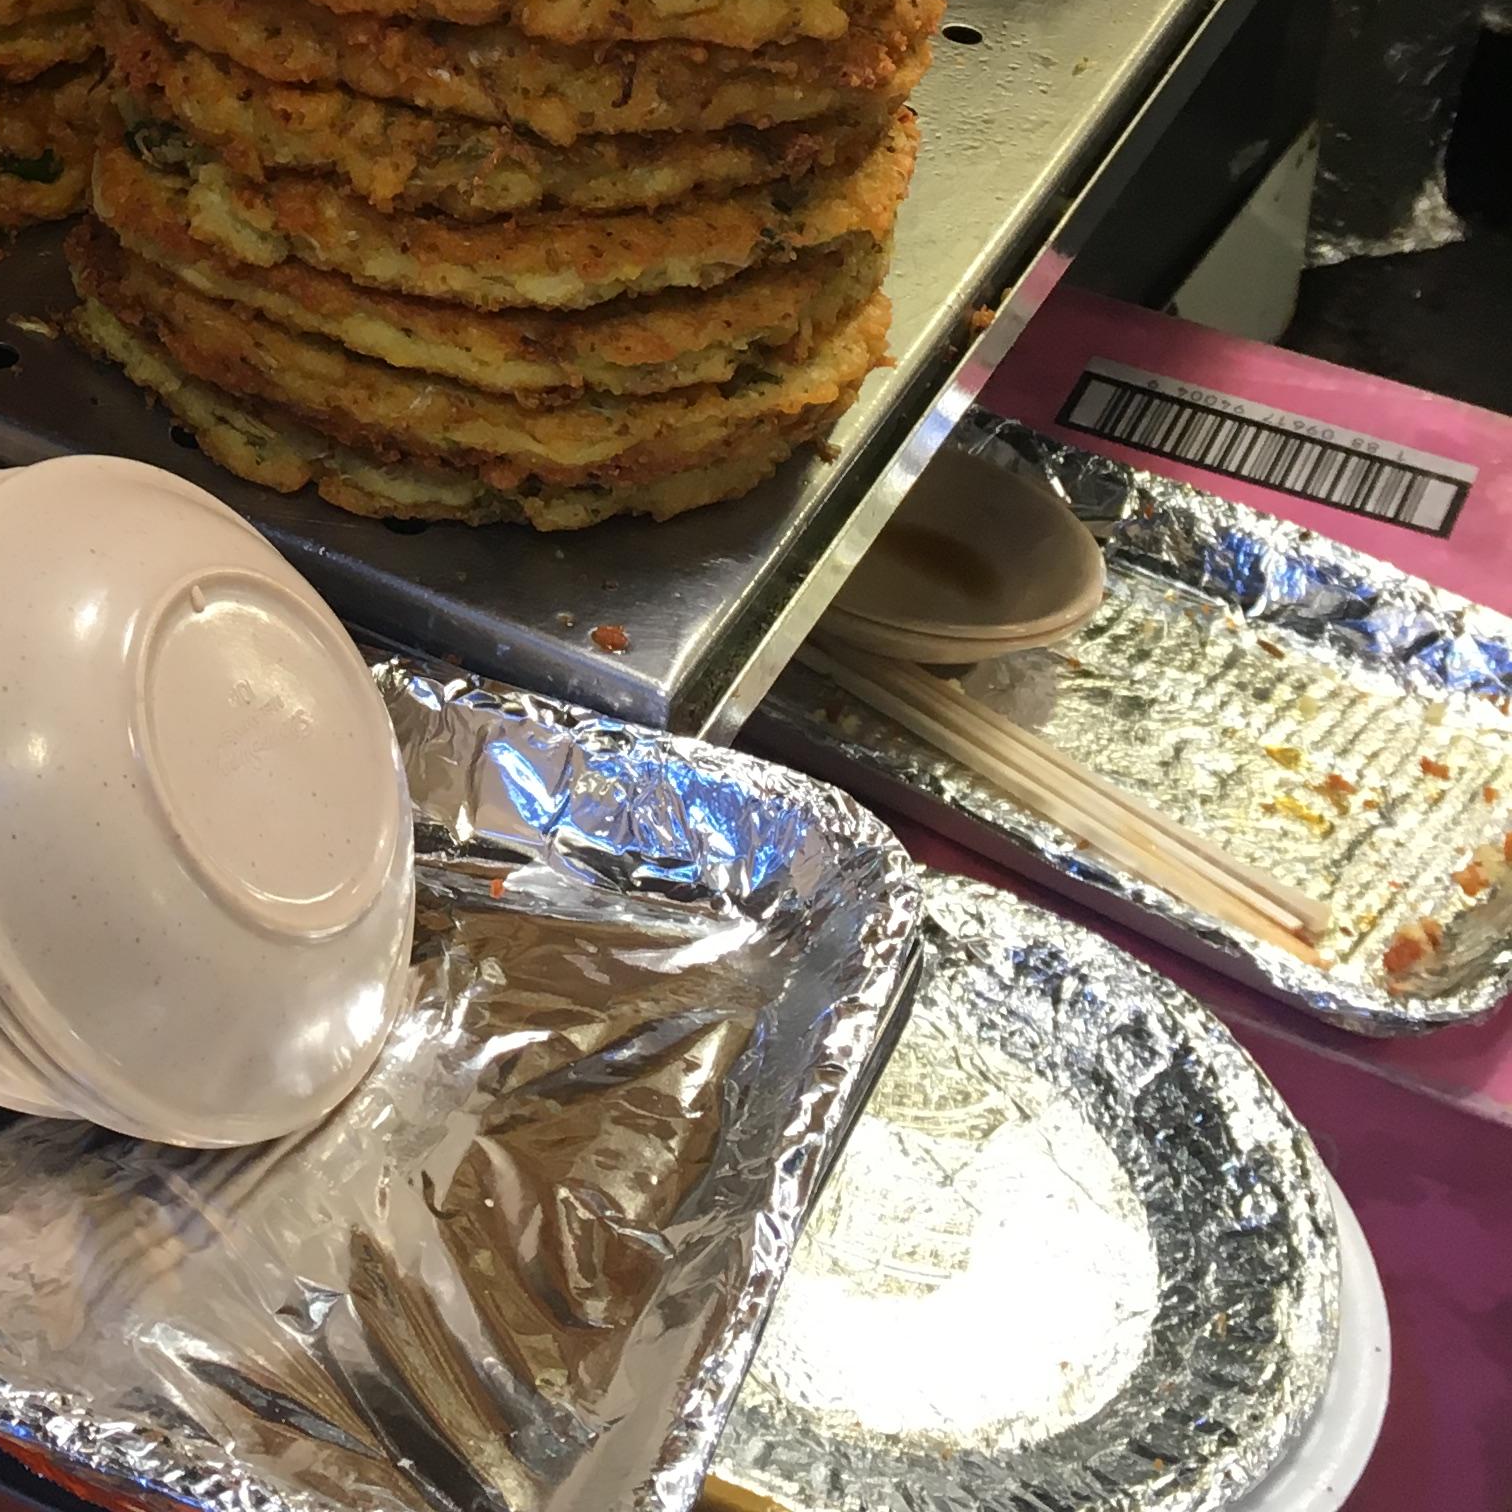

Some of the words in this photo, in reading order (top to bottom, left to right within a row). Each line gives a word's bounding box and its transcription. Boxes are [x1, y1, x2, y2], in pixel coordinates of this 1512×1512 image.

[1176, 387, 1246, 415] 94004
[1262, 412, 1335, 438] 09617
[1351, 437, 1379, 454] 88
